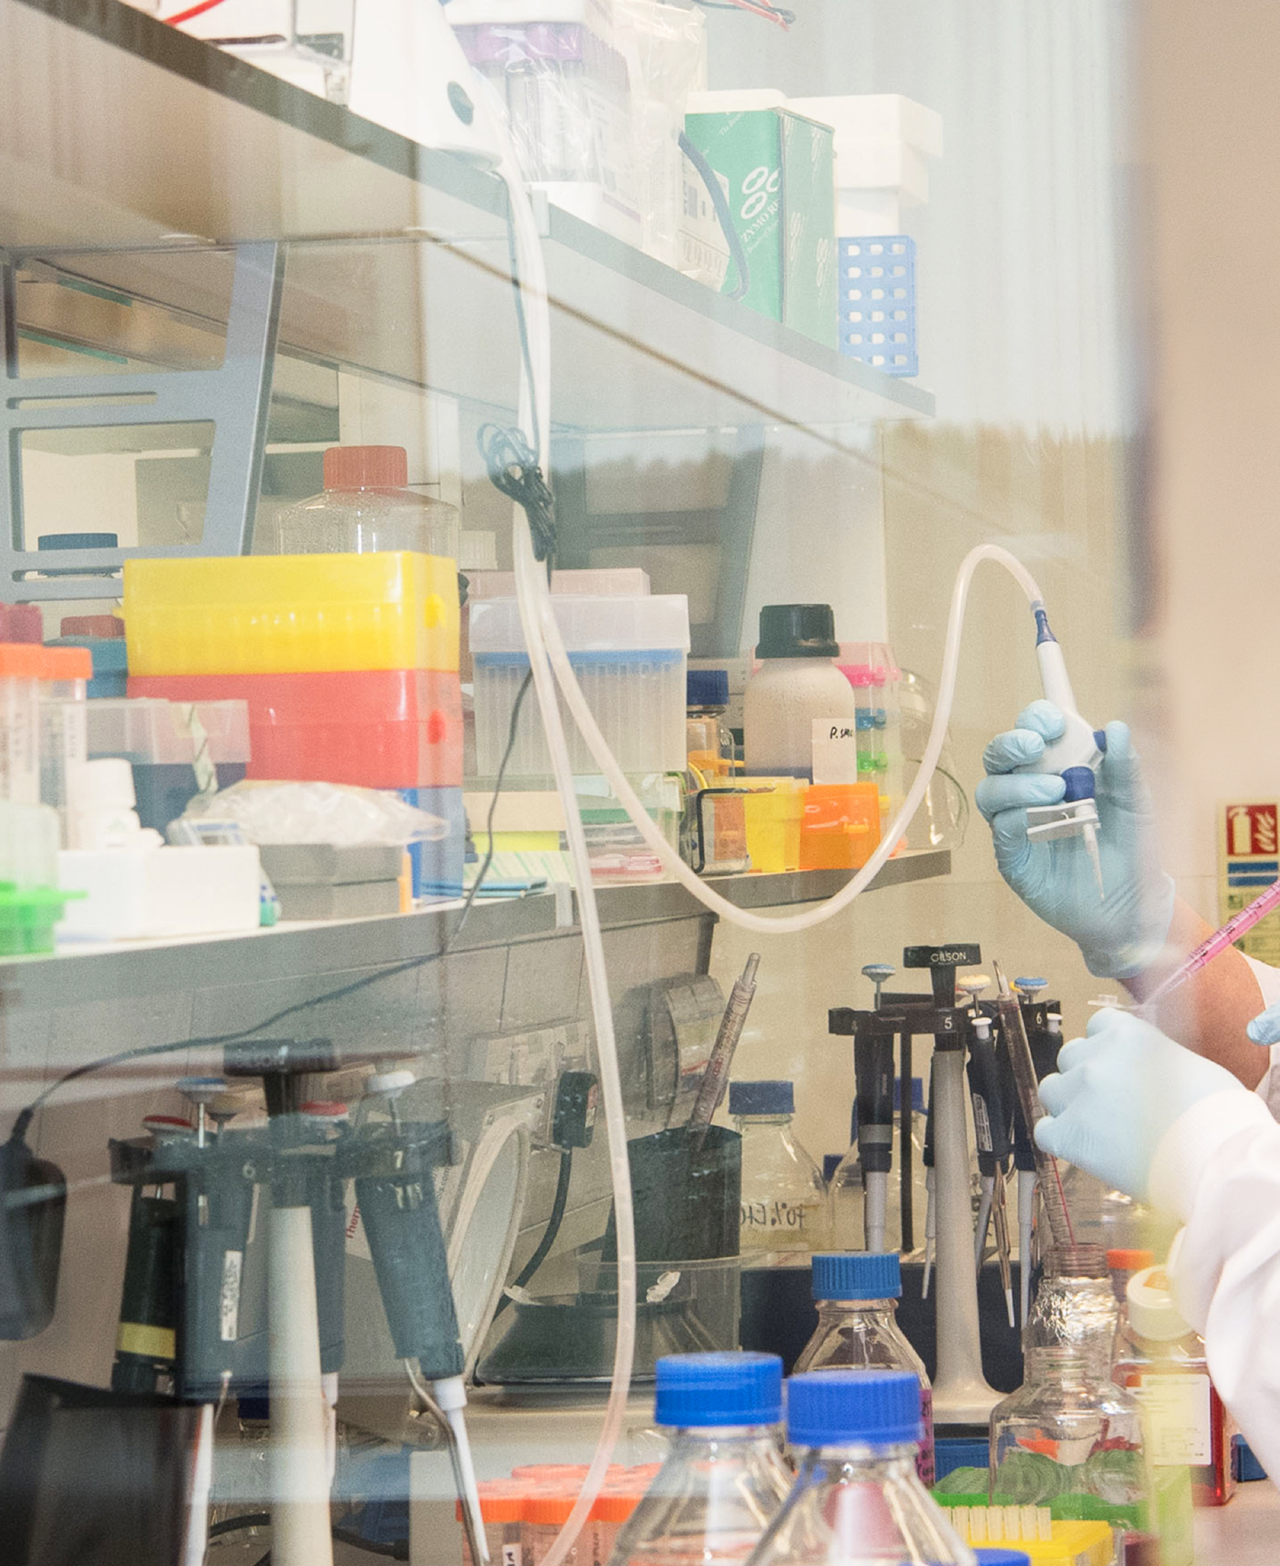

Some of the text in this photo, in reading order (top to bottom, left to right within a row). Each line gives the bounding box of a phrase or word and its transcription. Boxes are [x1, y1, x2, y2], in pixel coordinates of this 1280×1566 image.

[741, 212, 769, 243] ZYMO
[930, 950, 967, 963] GILSON
[944, 1017, 953, 1029] 5
[1036, 1012, 1043, 1025] 6
[242, 1162, 256, 1179] 6
